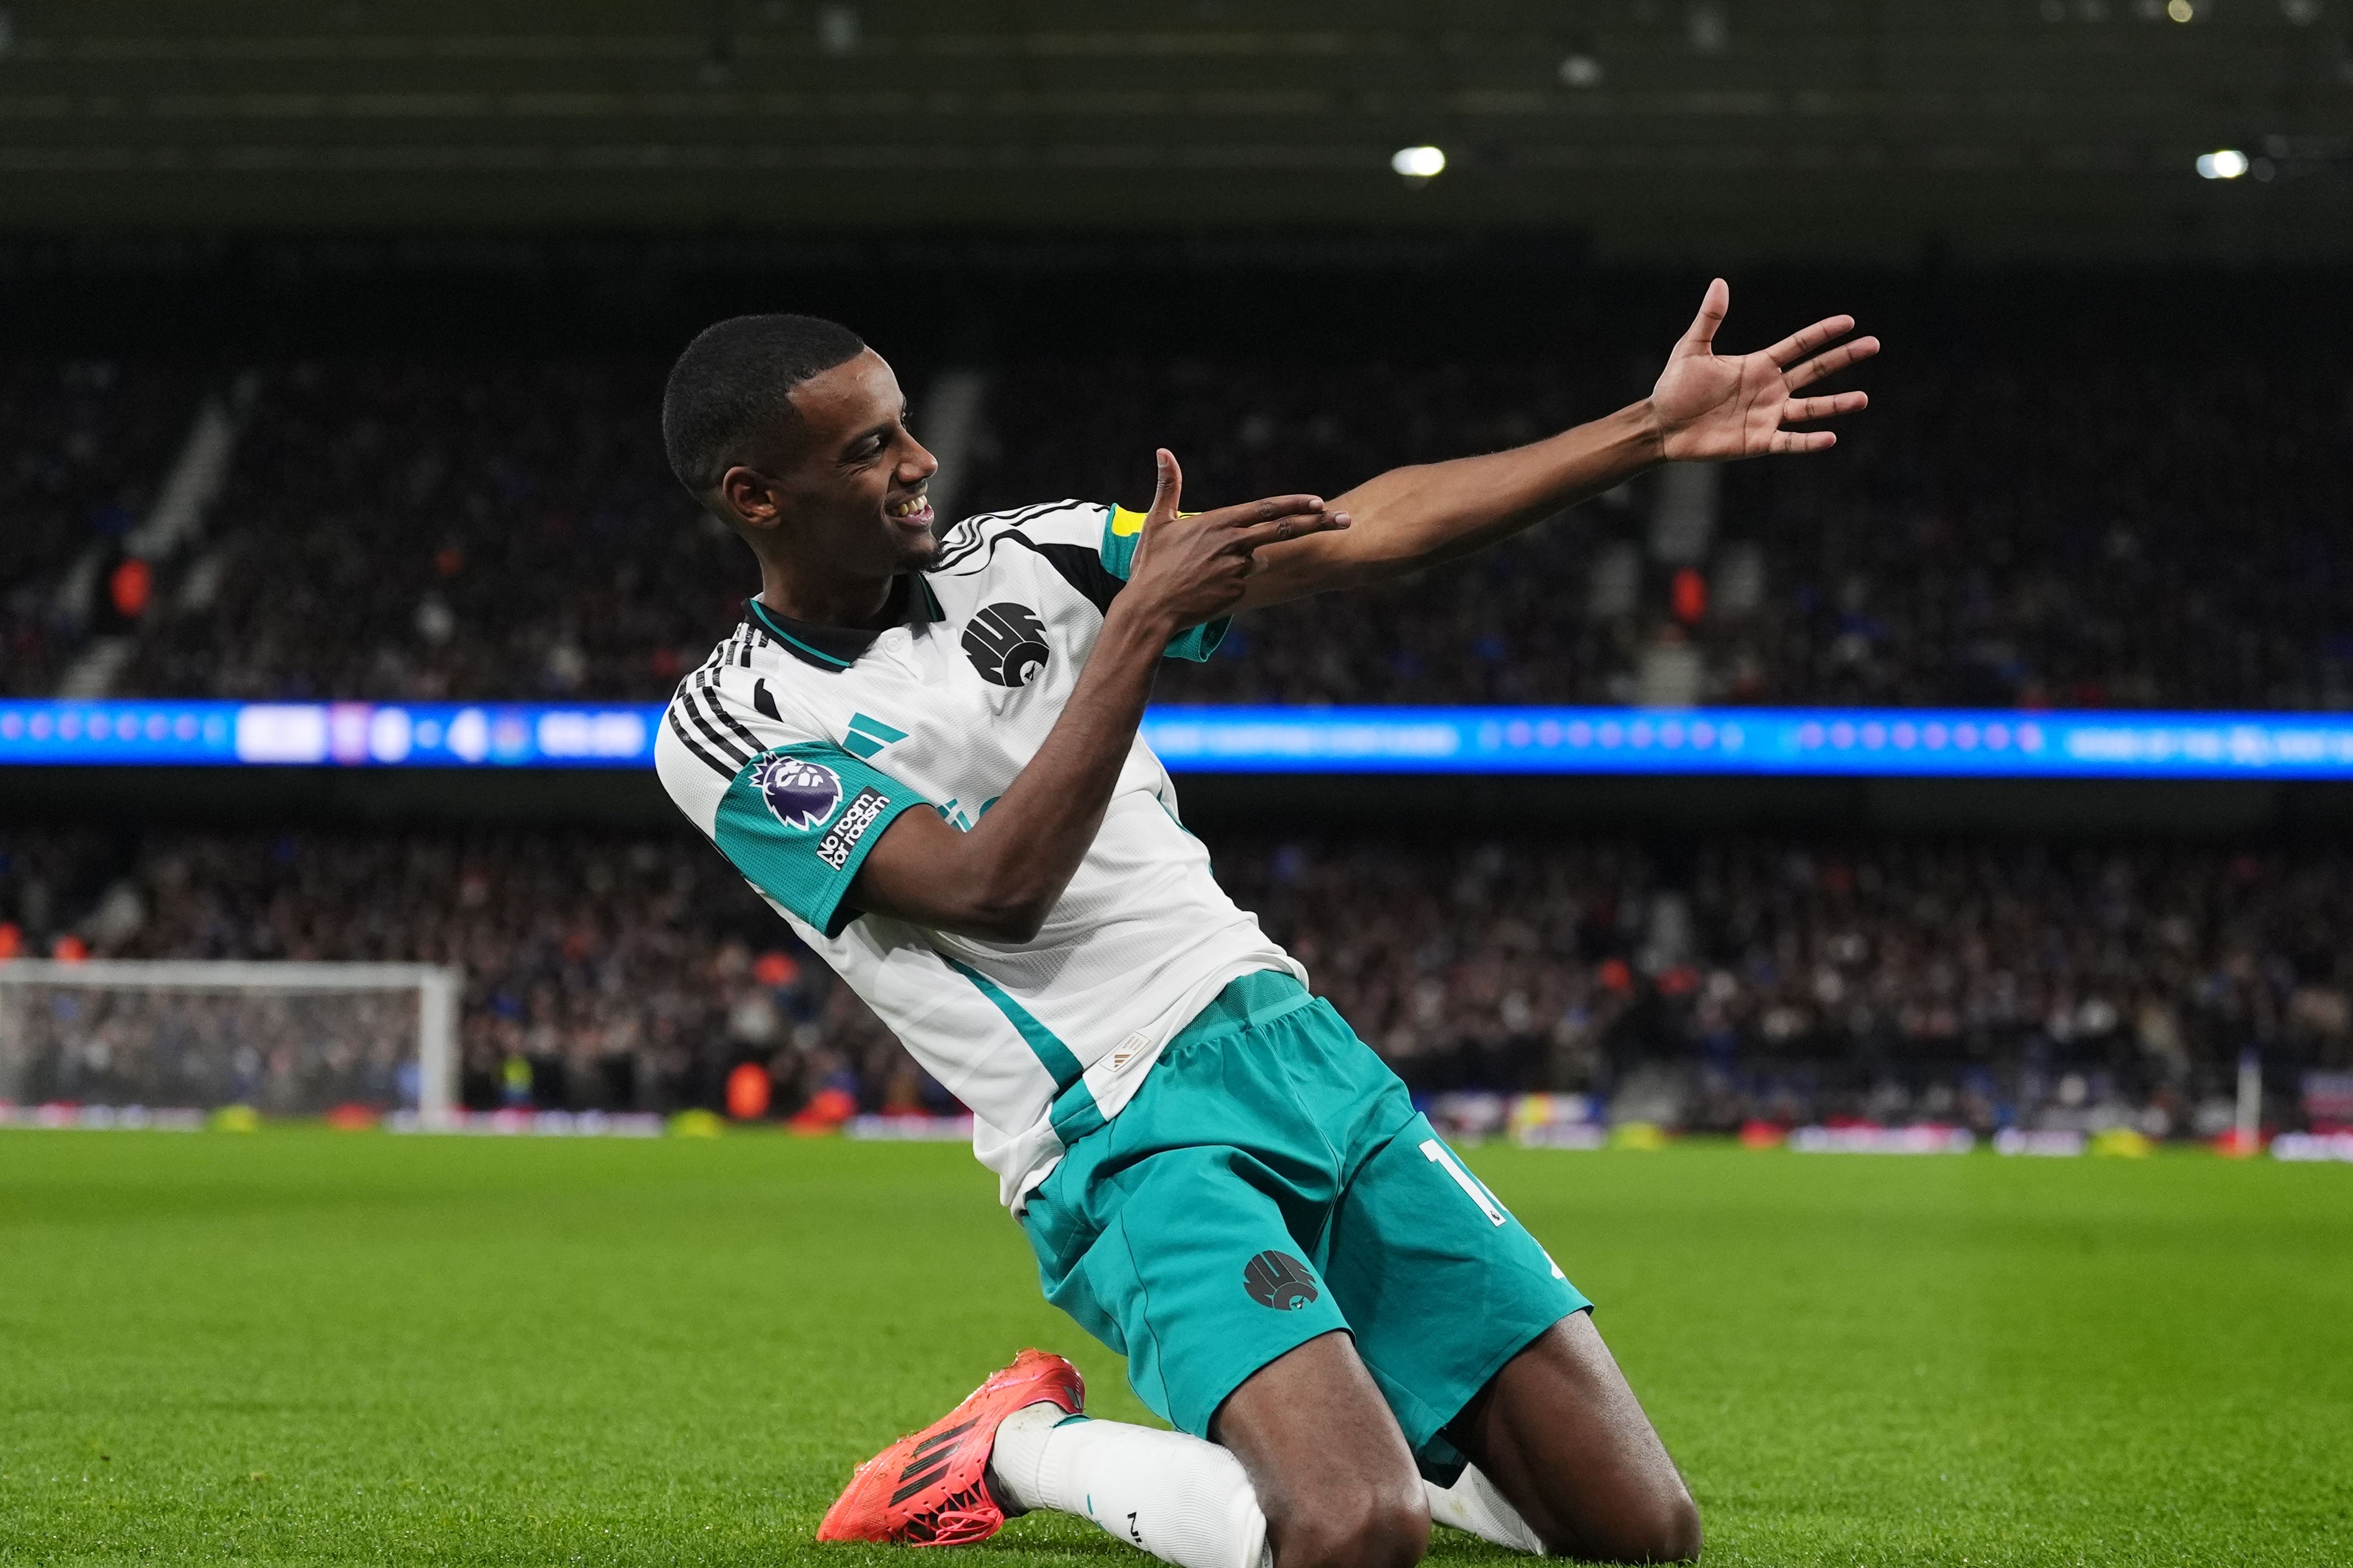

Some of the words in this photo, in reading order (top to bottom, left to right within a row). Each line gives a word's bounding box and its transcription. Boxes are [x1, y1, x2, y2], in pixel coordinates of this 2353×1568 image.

[816, 835, 839, 863] No
[833, 794, 874, 837] room
[828, 843, 849, 871] for
[843, 795, 891, 846] racism
[1418, 1139, 1507, 1227] 1
